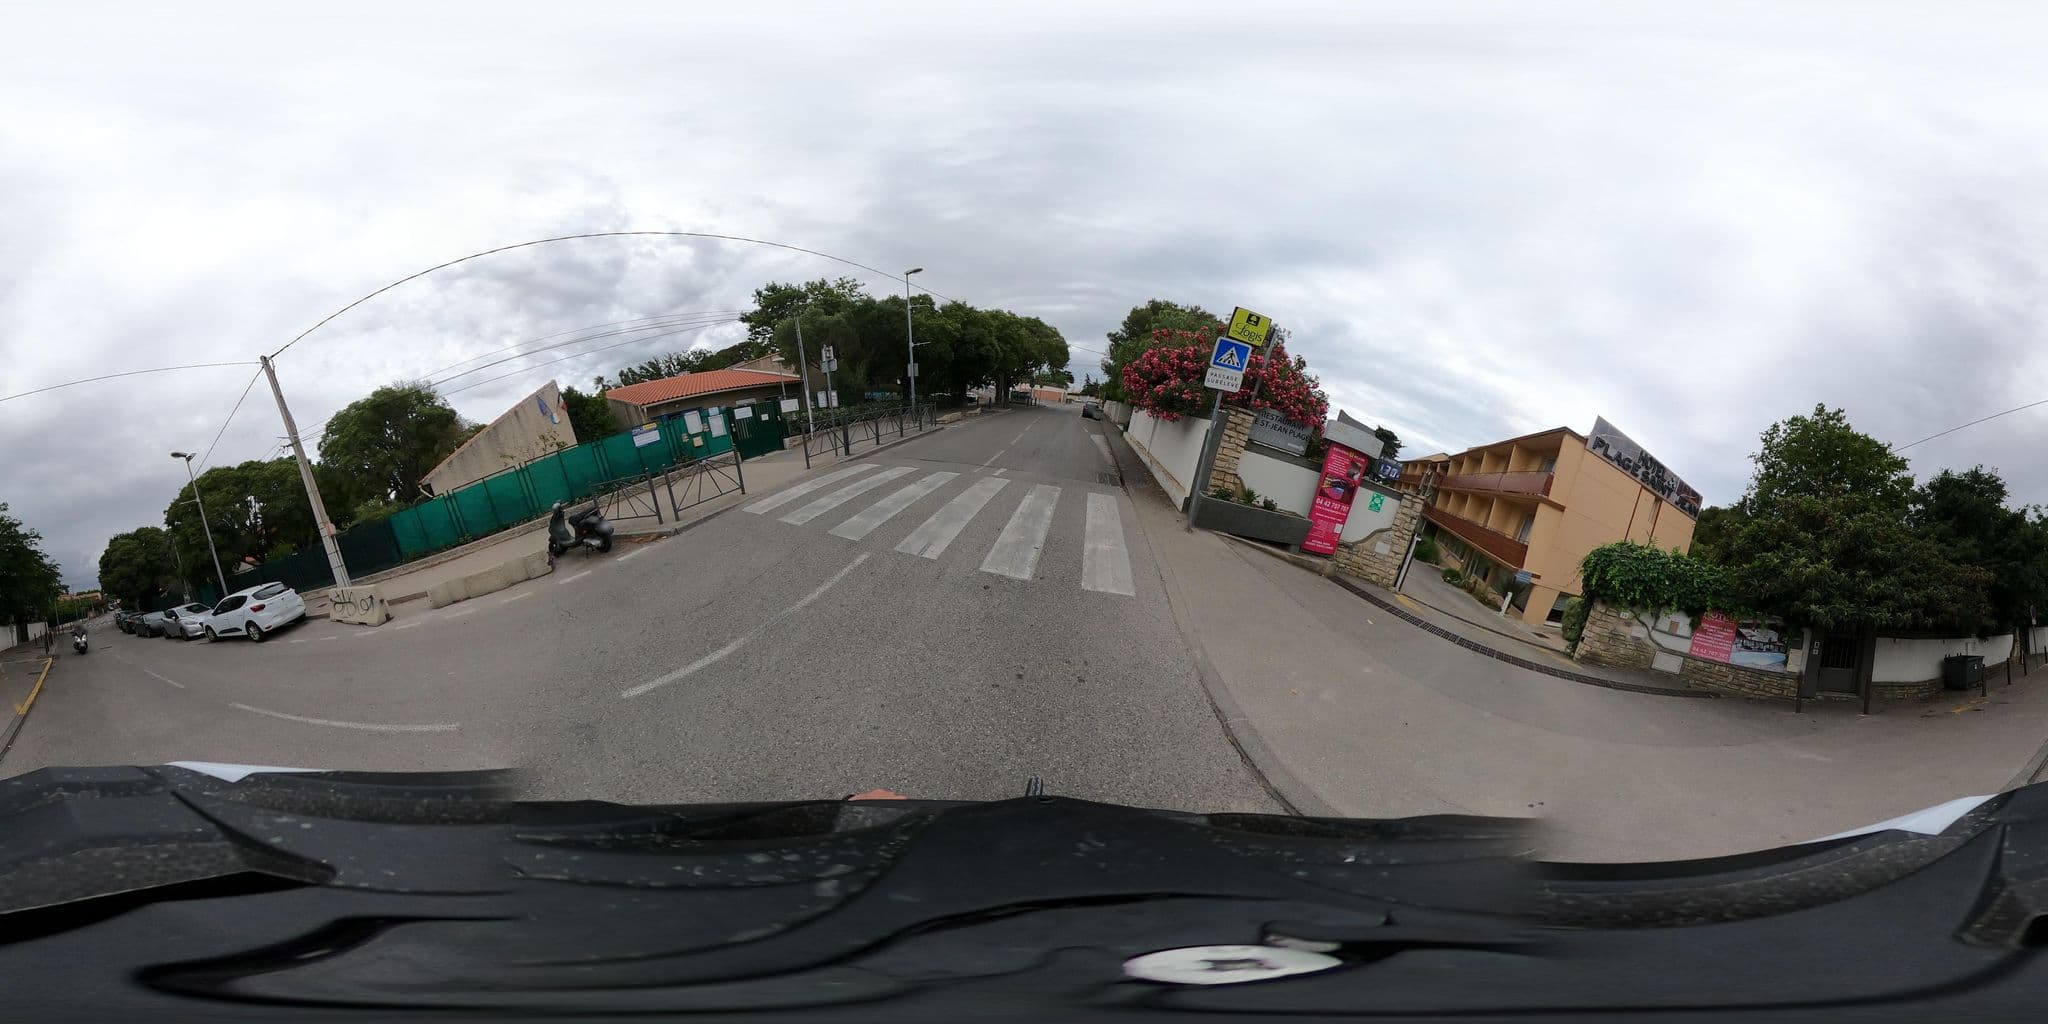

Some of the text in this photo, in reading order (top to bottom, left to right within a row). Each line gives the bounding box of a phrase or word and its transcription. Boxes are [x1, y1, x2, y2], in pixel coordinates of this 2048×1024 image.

[1231, 322, 1262, 341] Logis
[1210, 372, 1238, 382] PASSAGE
[1592, 436, 1641, 478] PLAGE
